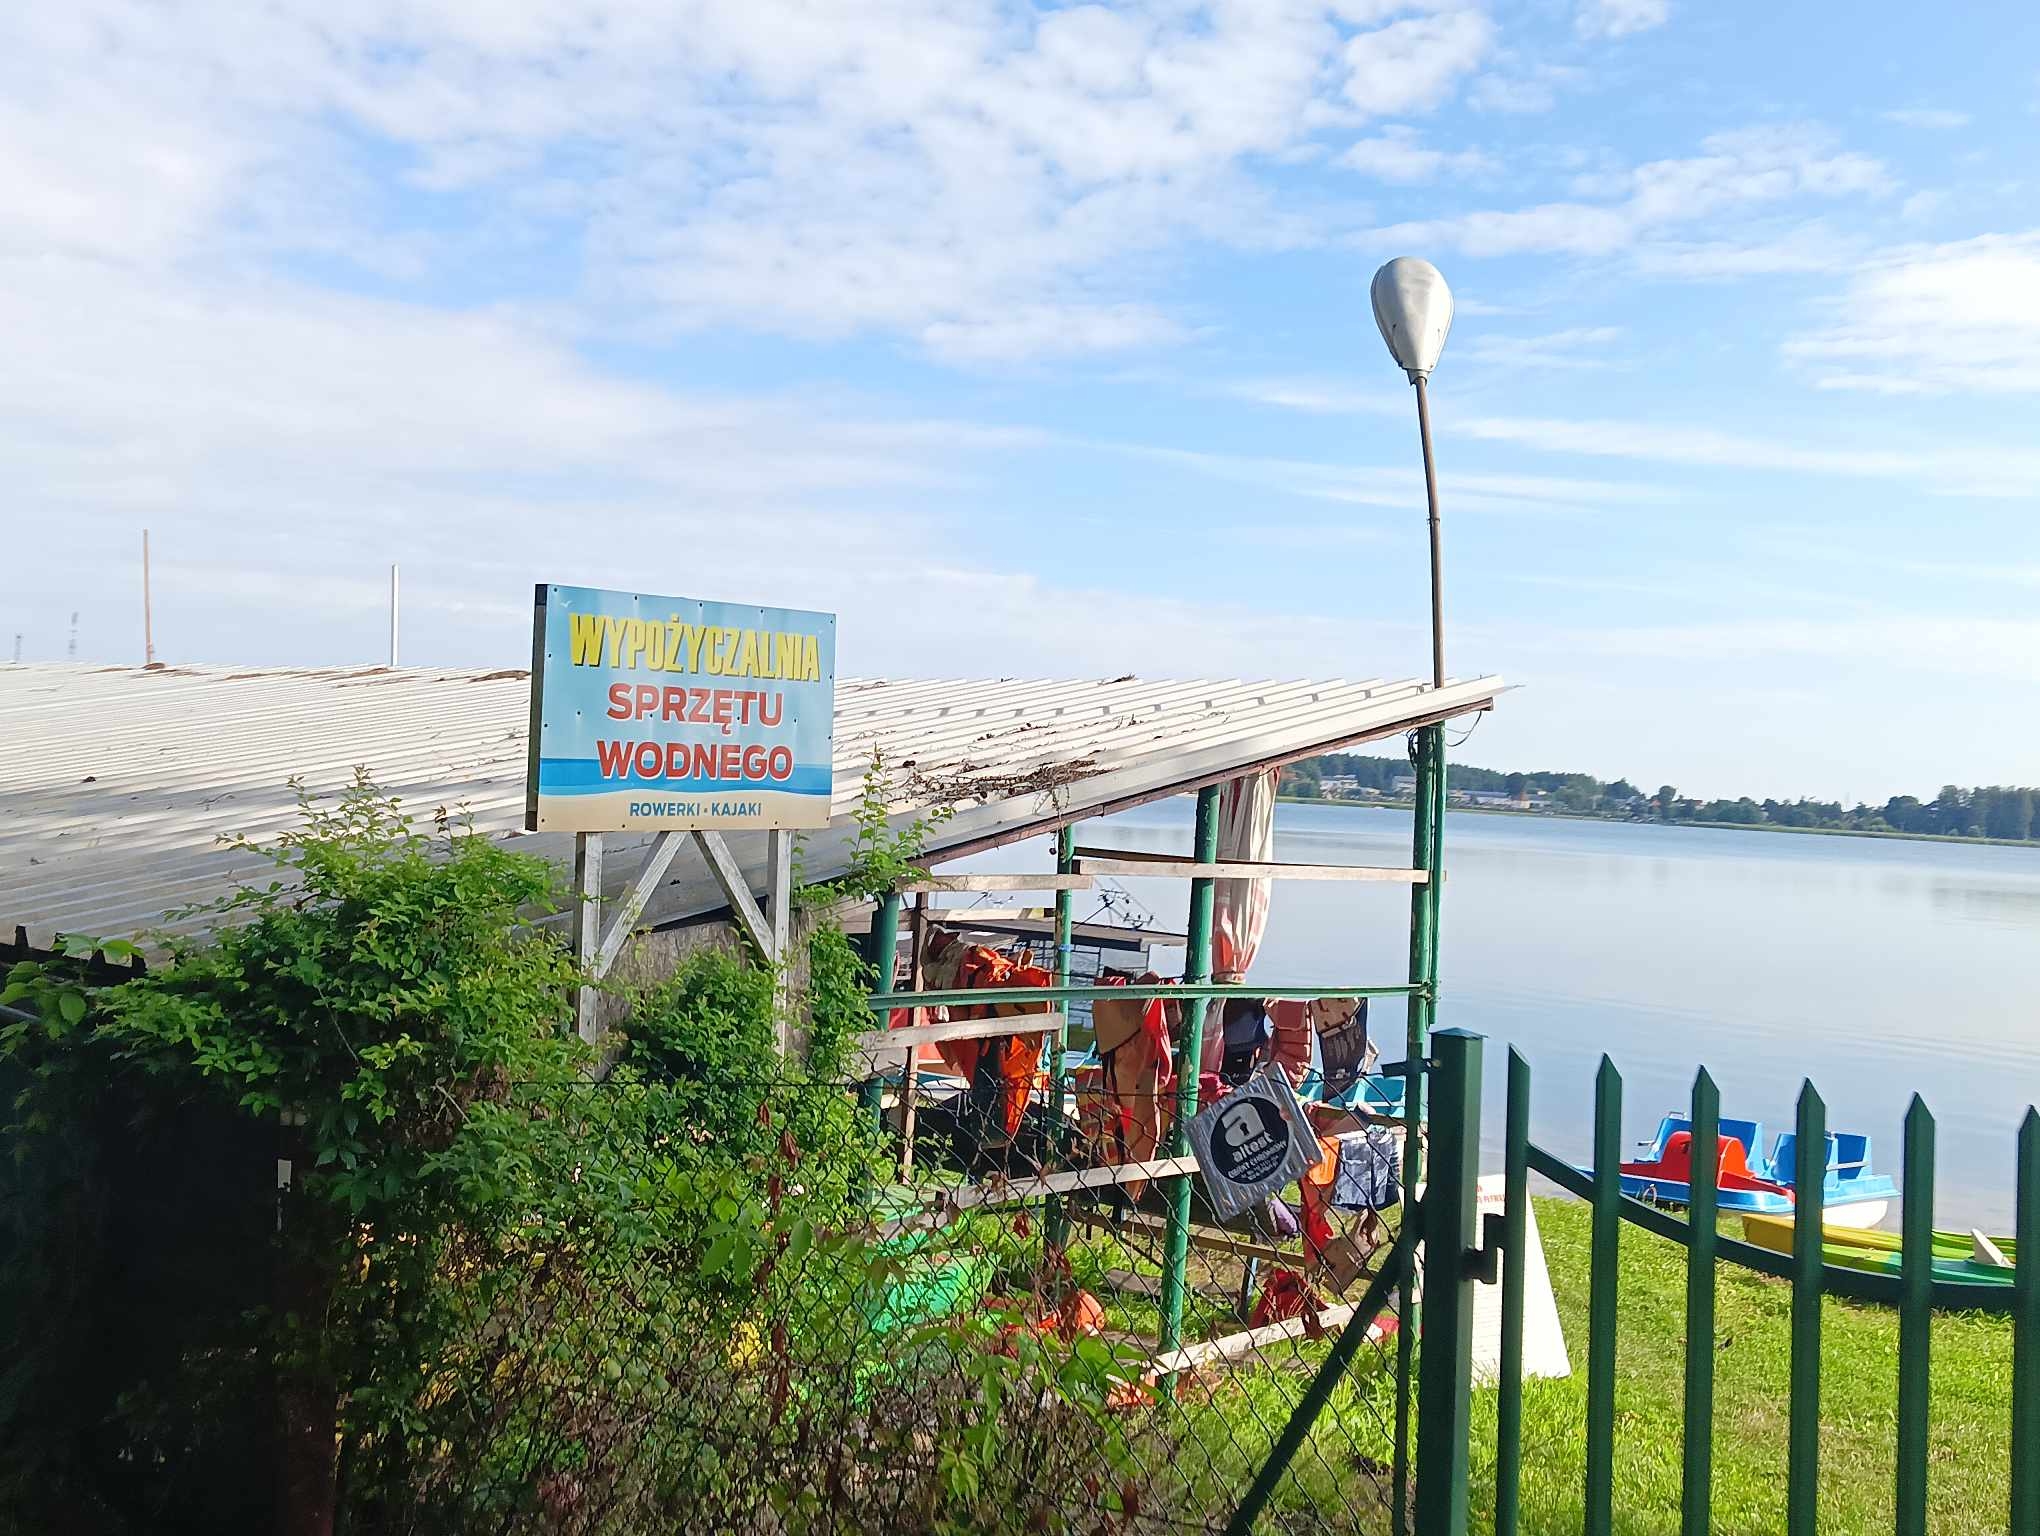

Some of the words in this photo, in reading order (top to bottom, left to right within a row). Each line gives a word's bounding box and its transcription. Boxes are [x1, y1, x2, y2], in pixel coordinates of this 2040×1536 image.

[571, 613, 820, 681] WYPOŻYCZALNIA
[607, 682, 784, 735] SPRZĘTU
[597, 740, 793, 781] WODNEGO
[629, 802, 700, 817] ROWERKI
[711, 802, 762, 817] KAJAKI
[1232, 1131, 1273, 1163] altest
